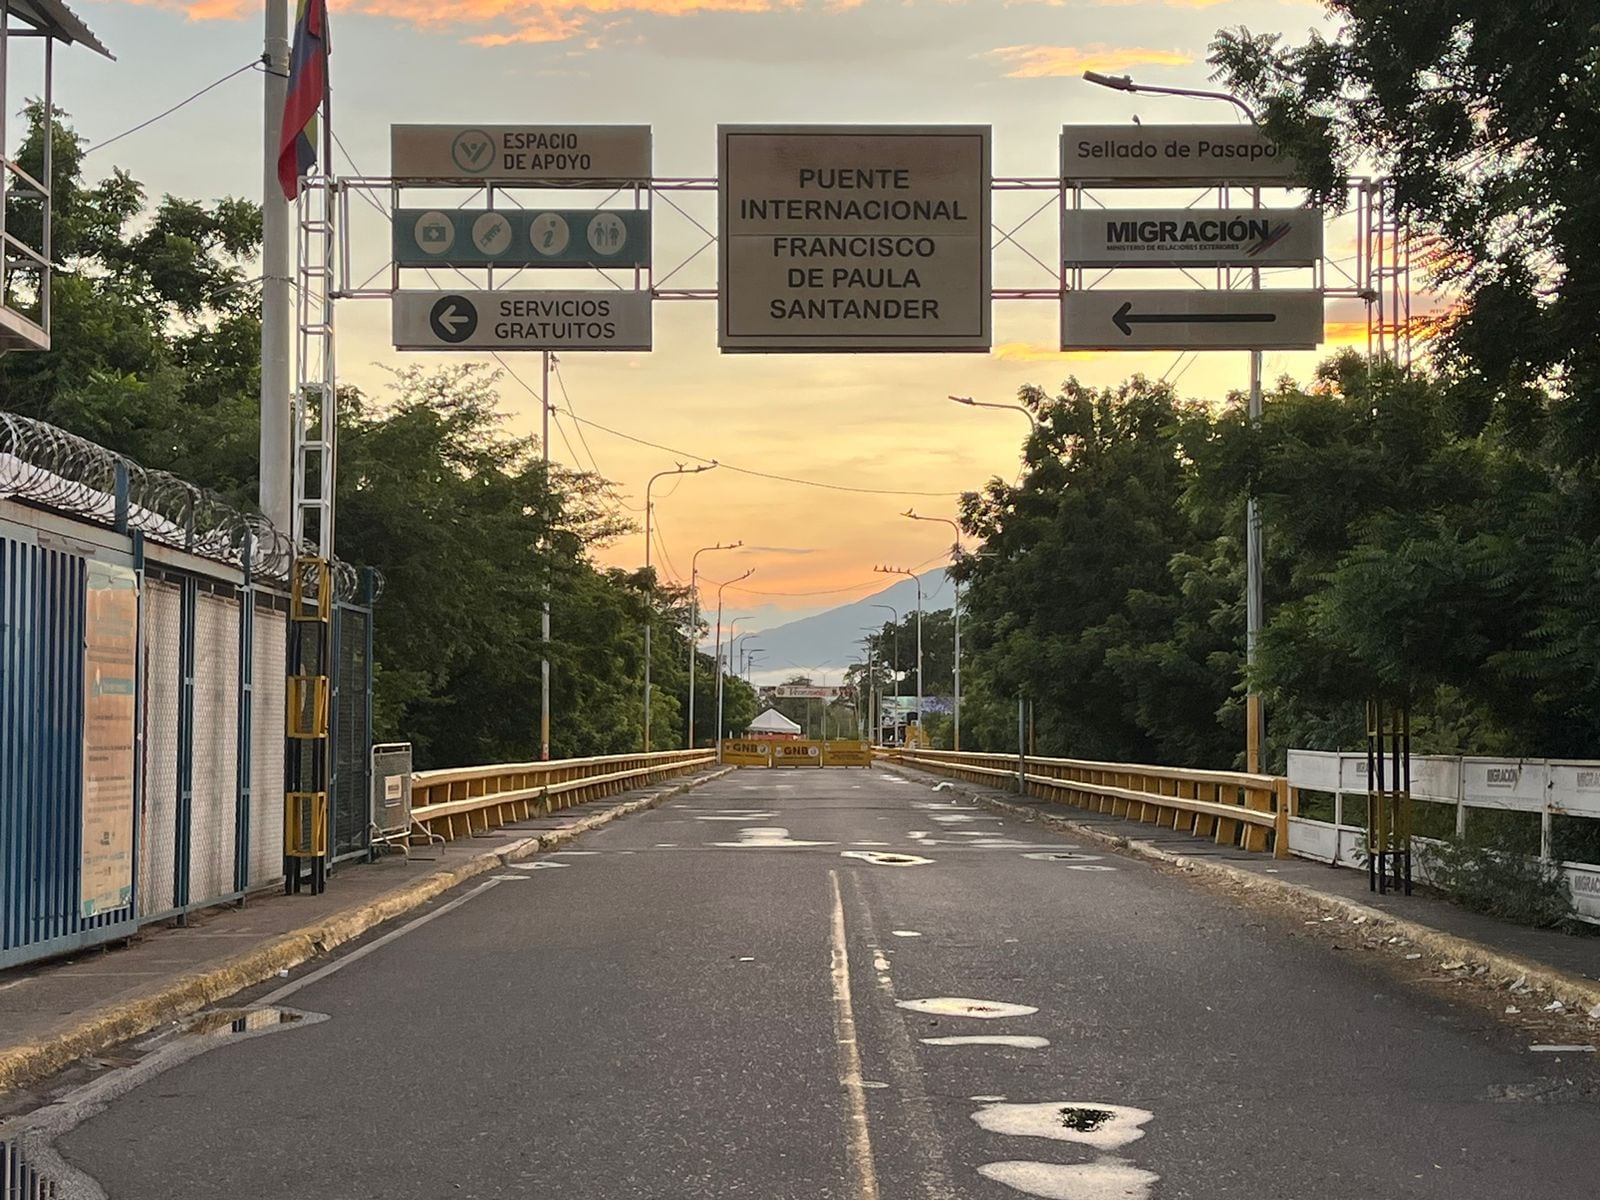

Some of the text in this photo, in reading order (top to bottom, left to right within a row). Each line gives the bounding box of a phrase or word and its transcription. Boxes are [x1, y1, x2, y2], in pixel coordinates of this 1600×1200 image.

[503, 133, 578, 149] ESPACIO
[1077, 141, 1158, 159] Sellado
[1164, 141, 1191, 159] de
[503, 154, 591, 170] DE APOYO
[799, 169, 910, 189] PUENTE
[740, 200, 968, 220] INTERNACIONAL
[1106, 216, 1269, 243] MIGRACIÓN
[773, 237, 936, 258] FRANCISCO
[787, 268, 921, 288] DE PAULA
[499, 301, 611, 317] SERVICIOS
[770, 299, 939, 320] SANTANDER
[494, 322, 616, 339] GRATUITOS
